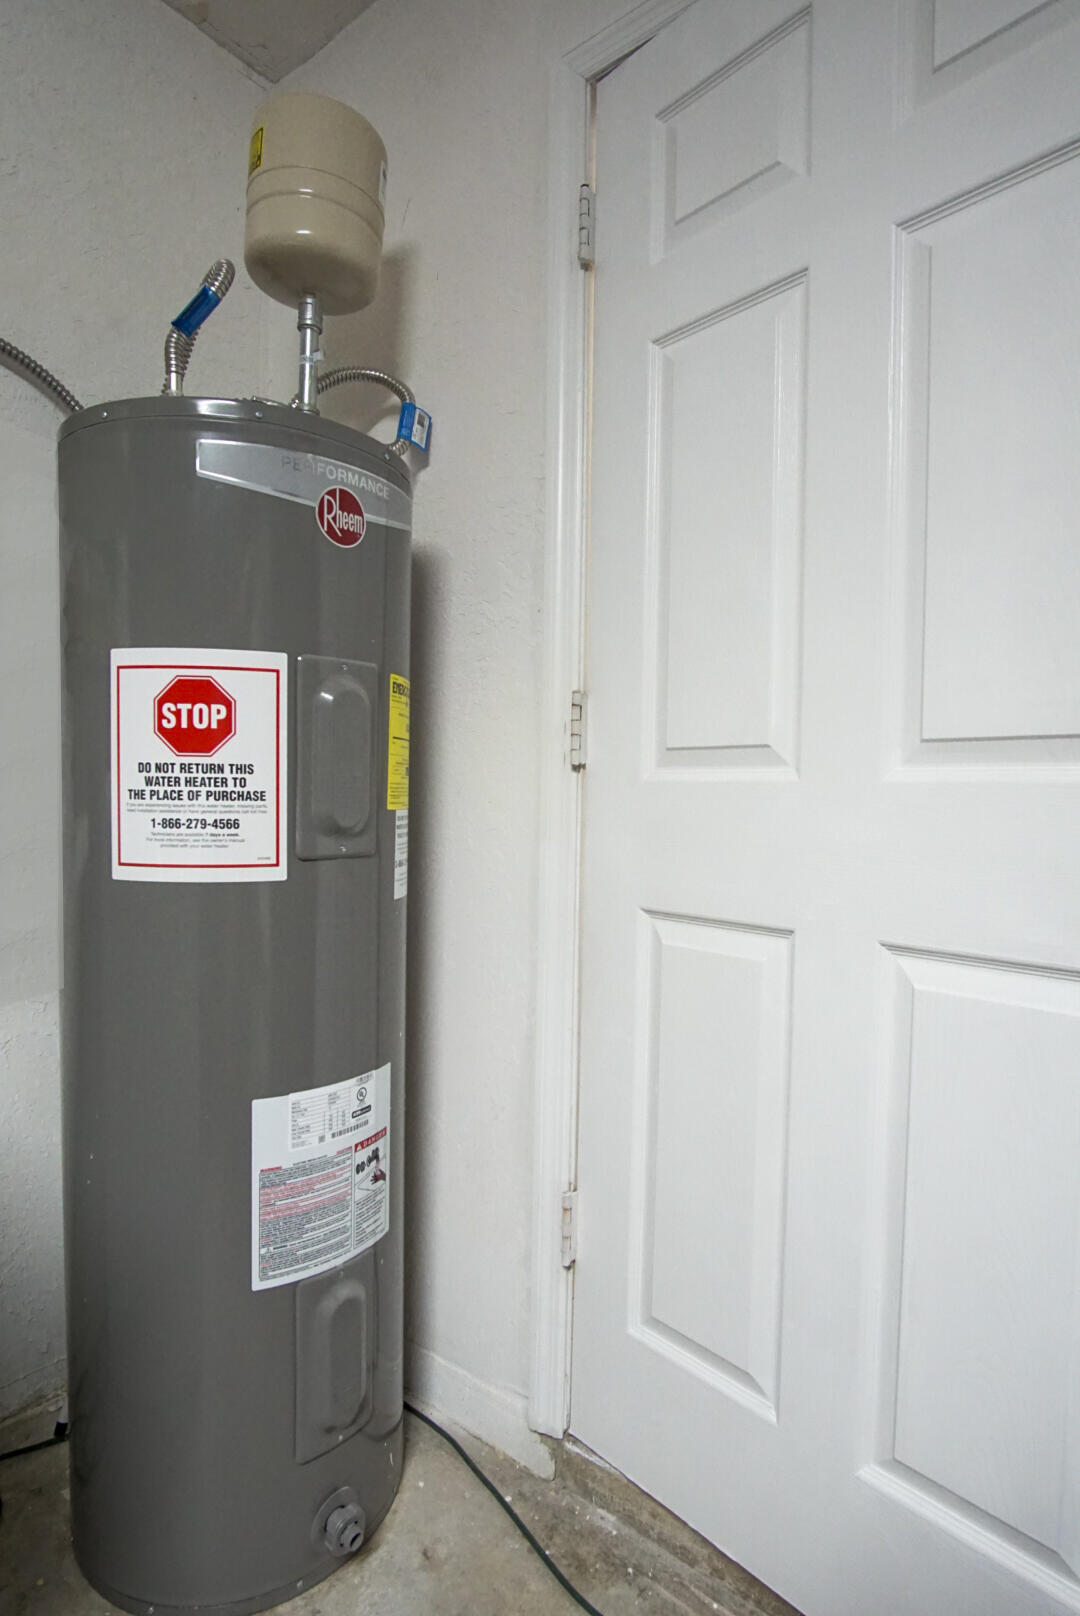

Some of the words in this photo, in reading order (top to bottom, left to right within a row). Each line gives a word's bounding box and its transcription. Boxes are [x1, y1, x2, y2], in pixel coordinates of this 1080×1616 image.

[281, 455, 391, 500] PERFORMANCE
[323, 487, 363, 537] Rheem
[161, 702, 227, 729] STOP
[137, 762, 152, 773] DO
[154, 762, 176, 774] NOT
[179, 763, 225, 774] RETURN
[228, 763, 255, 775] THIS
[144, 776, 181, 787] WATER
[184, 776, 228, 788] HEATER
[231, 777, 247, 788] TO
[128, 789, 146, 800] THE
[149, 789, 184, 801] PLACE
[187, 790, 202, 801] OF
[206, 790, 267, 802] PURCHASE
[151, 818, 240, 829] 1-866-279-4566
